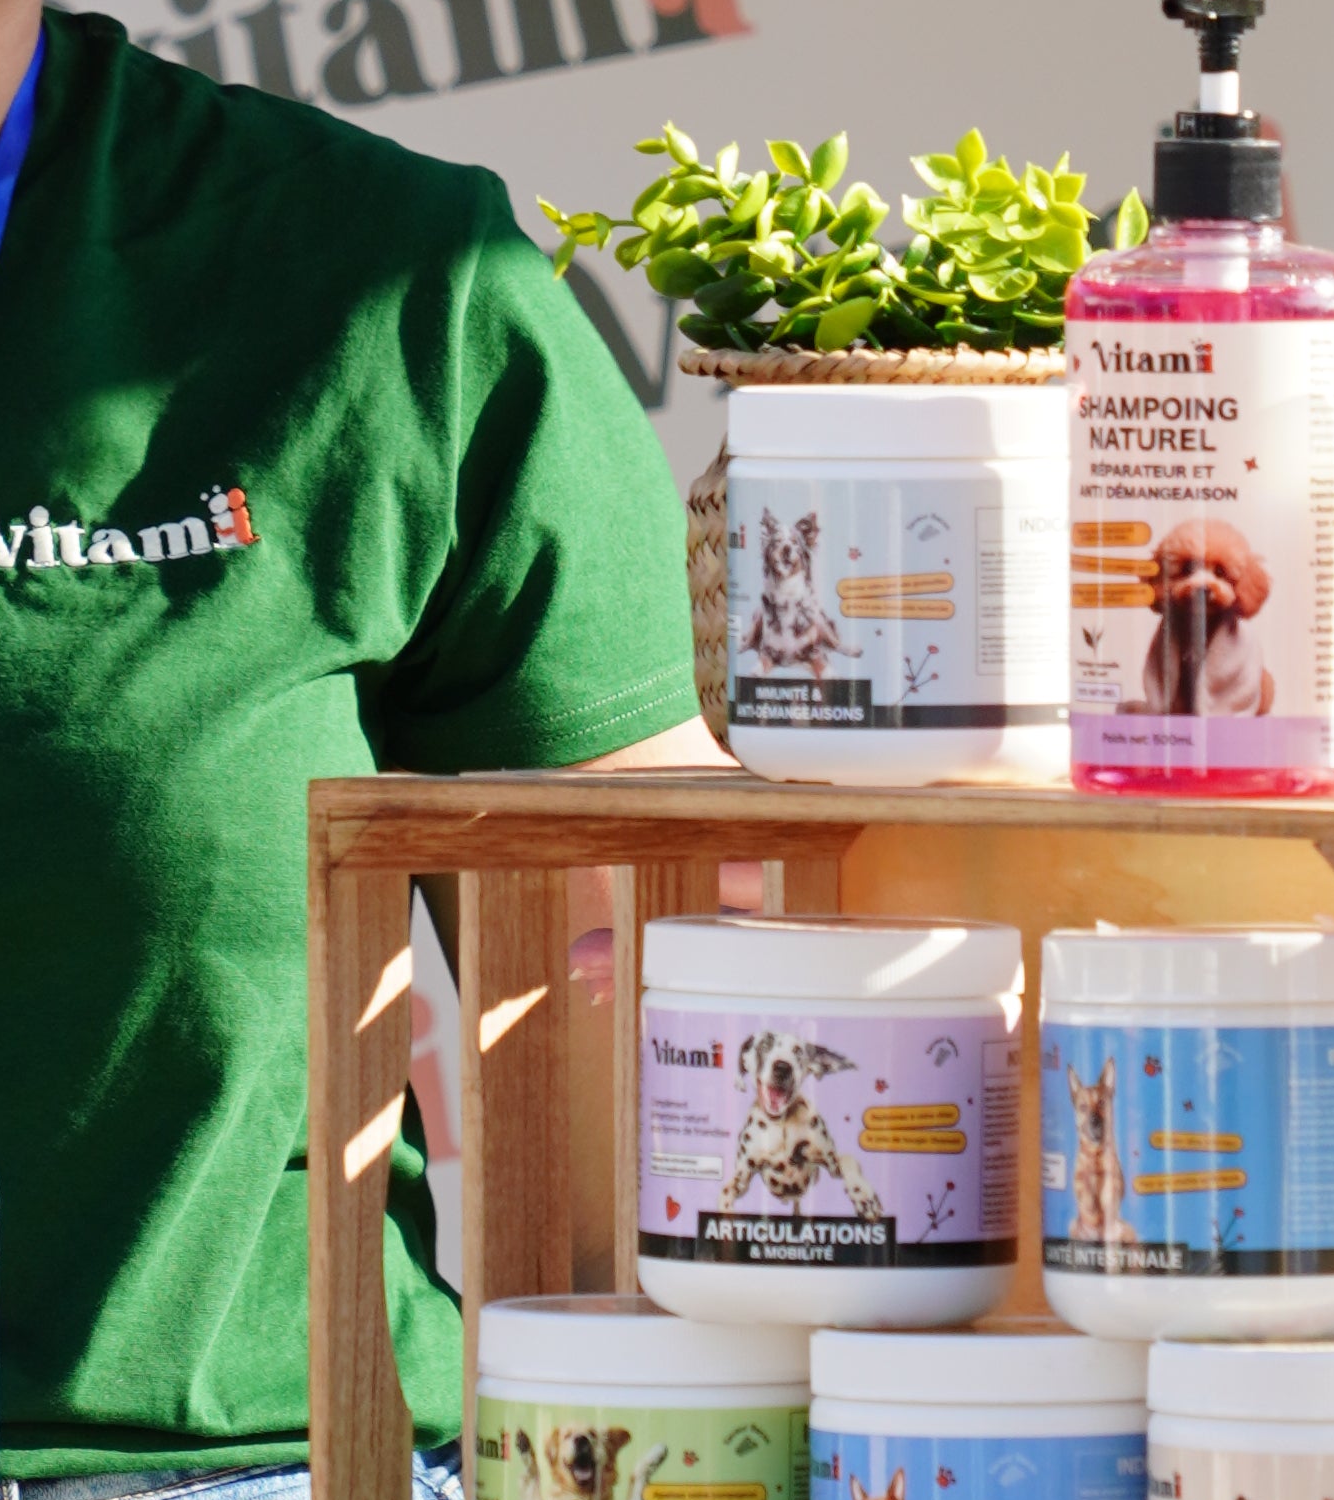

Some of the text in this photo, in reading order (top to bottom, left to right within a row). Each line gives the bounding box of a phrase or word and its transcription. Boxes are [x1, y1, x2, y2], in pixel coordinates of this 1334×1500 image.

[1079, 397, 1238, 421] SHAMPOING
[1090, 427, 1218, 451] NATUREL
[1090, 461, 1214, 478] RÉPARATEUR ET
[1106, 483, 1238, 500] DÉMANGEAISON
[704, 1219, 887, 1245] ARTICULATIONS
[750, 1246, 760, 1259] &
[1075, 1247, 1183, 1270] INTESTINALE
